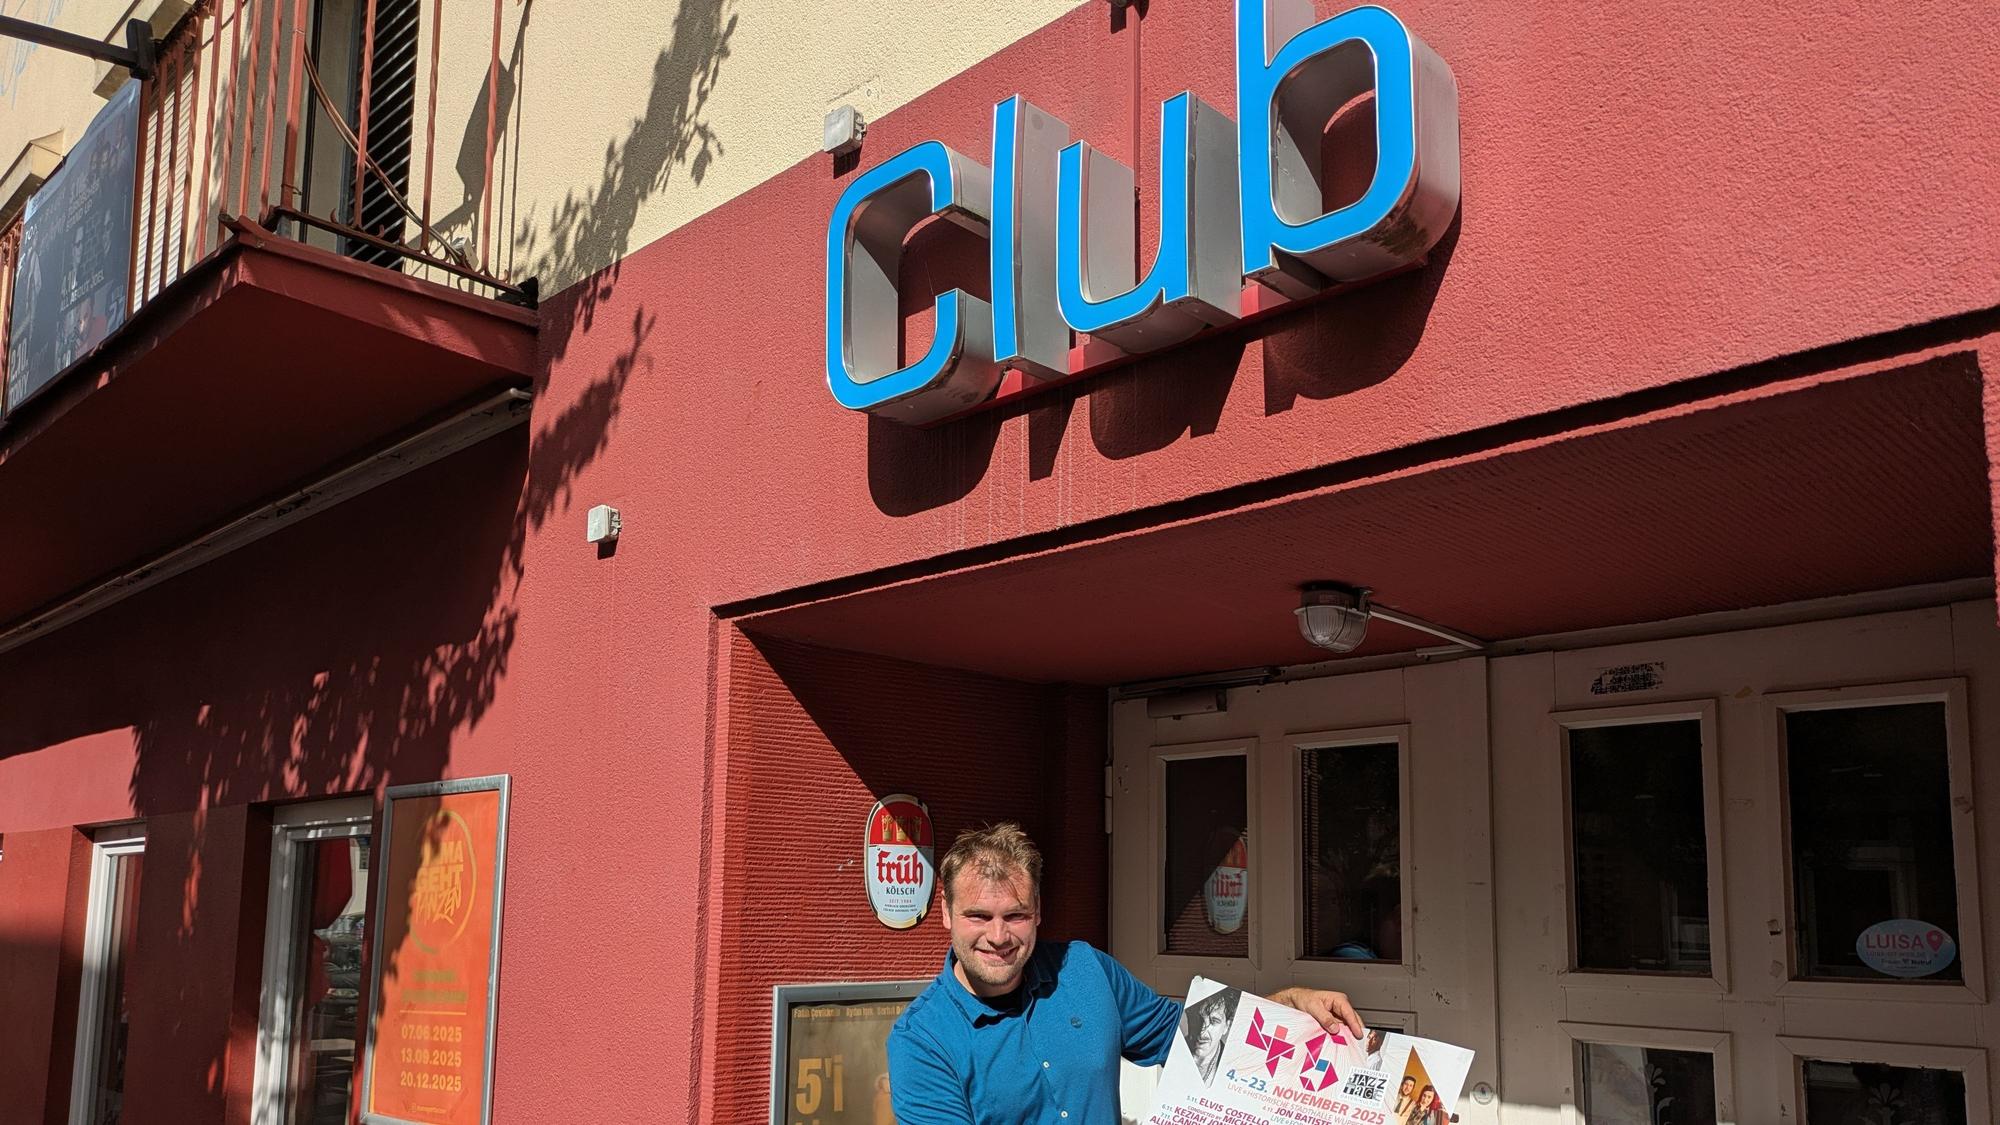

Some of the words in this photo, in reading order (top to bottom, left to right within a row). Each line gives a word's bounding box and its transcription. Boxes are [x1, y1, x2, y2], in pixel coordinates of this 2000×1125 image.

[886, 886, 915, 895] KÖLSCH
[1865, 934, 1924, 949] LUISA
[401, 1024, 463, 1043] 07.06.2025
[401, 1048, 463, 1068] 13.09.2025
[400, 1071, 463, 1092] 20.12.2025
[1348, 1073, 1387, 1090] JAZZ
[1199, 1097, 1224, 1113] ELVIS
[1225, 1107, 1269, 1125] COSTELLO
[1272, 1085, 1350, 1116] NOVEMBER
[1351, 1107, 1386, 1125] 2025
[1275, 1107, 1294, 1119] JON
[1174, 1106, 1207, 1124] KEZIAH
